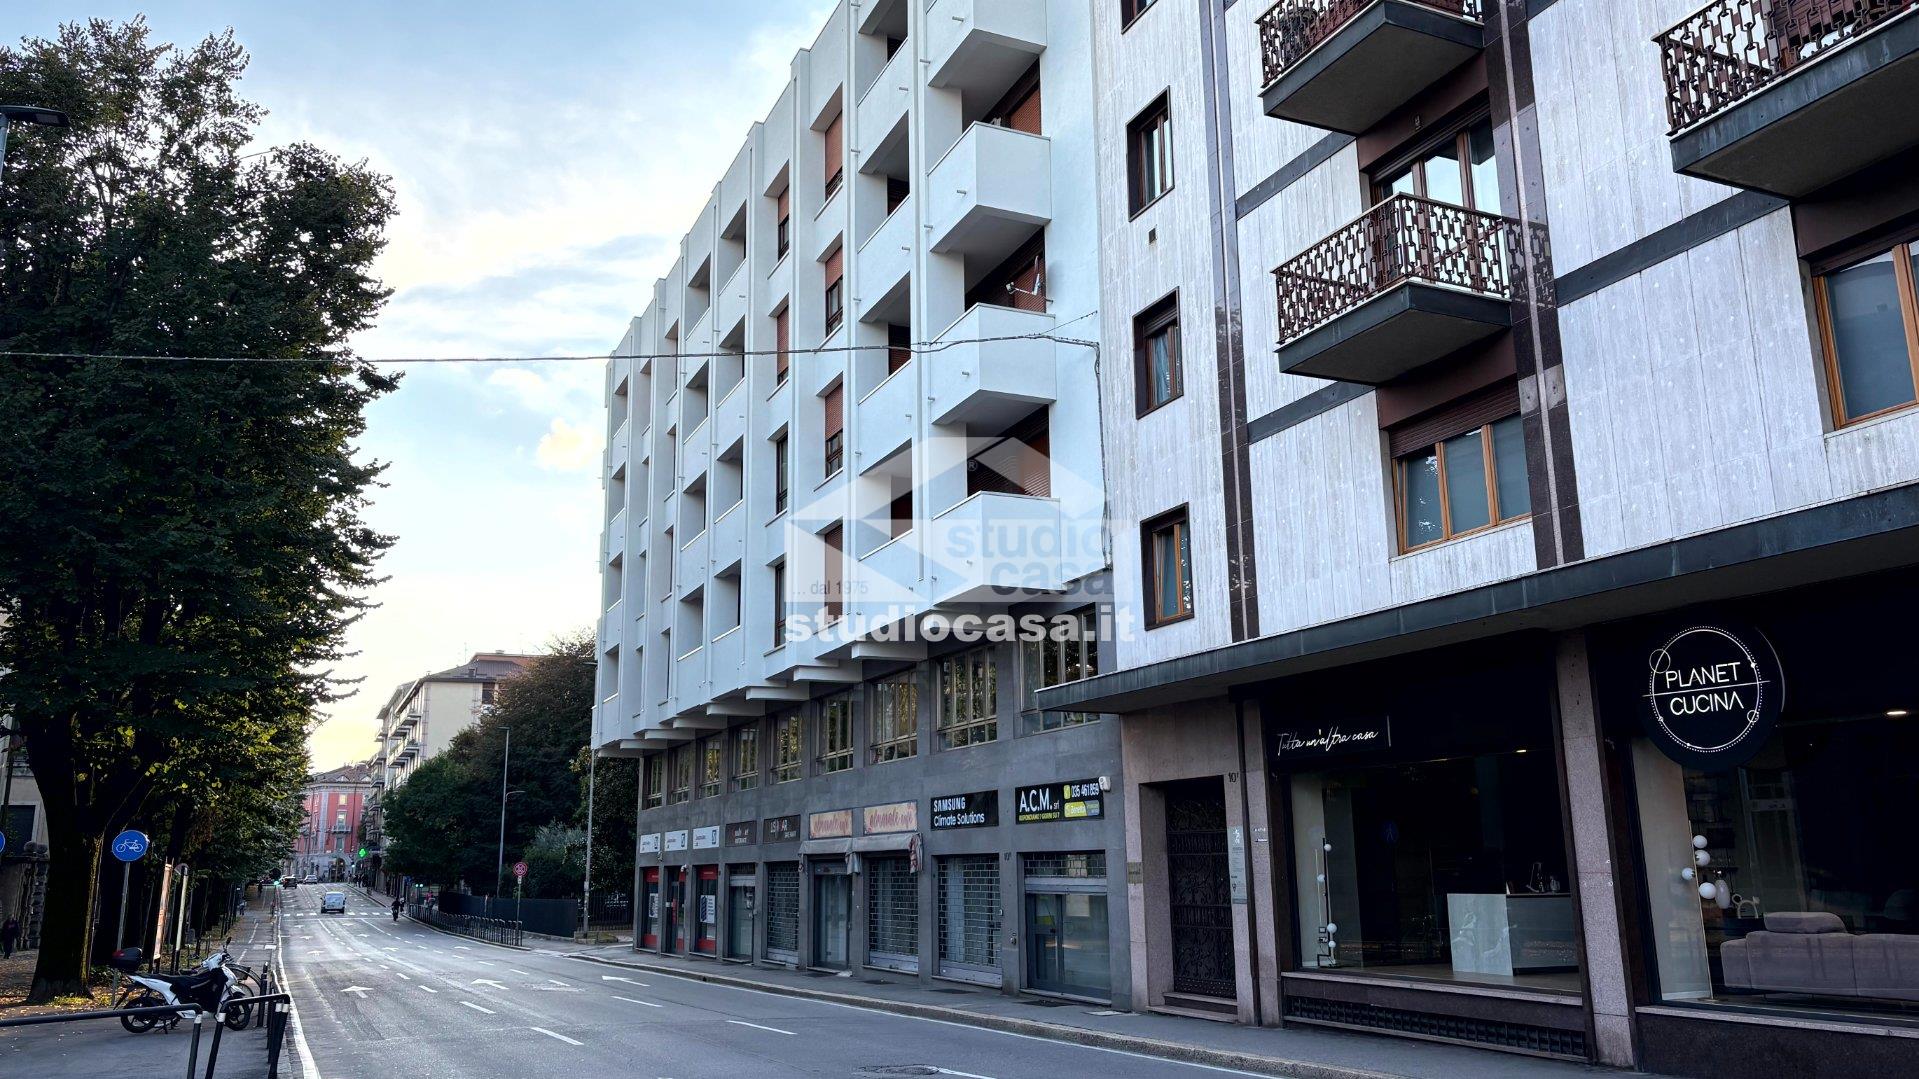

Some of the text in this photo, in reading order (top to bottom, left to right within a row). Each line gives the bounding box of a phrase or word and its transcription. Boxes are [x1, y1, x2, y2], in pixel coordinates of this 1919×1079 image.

[1665, 661, 1741, 689] PLANET
[1669, 691, 1745, 716] CUCINA
[1277, 732, 1306, 756] Tutta
[1351, 730, 1379, 741] casa
[933, 796, 966, 813] SAMSUNG
[1019, 787, 1053, 813] A.C.M.
[933, 811, 985, 827] Climate Solutions
